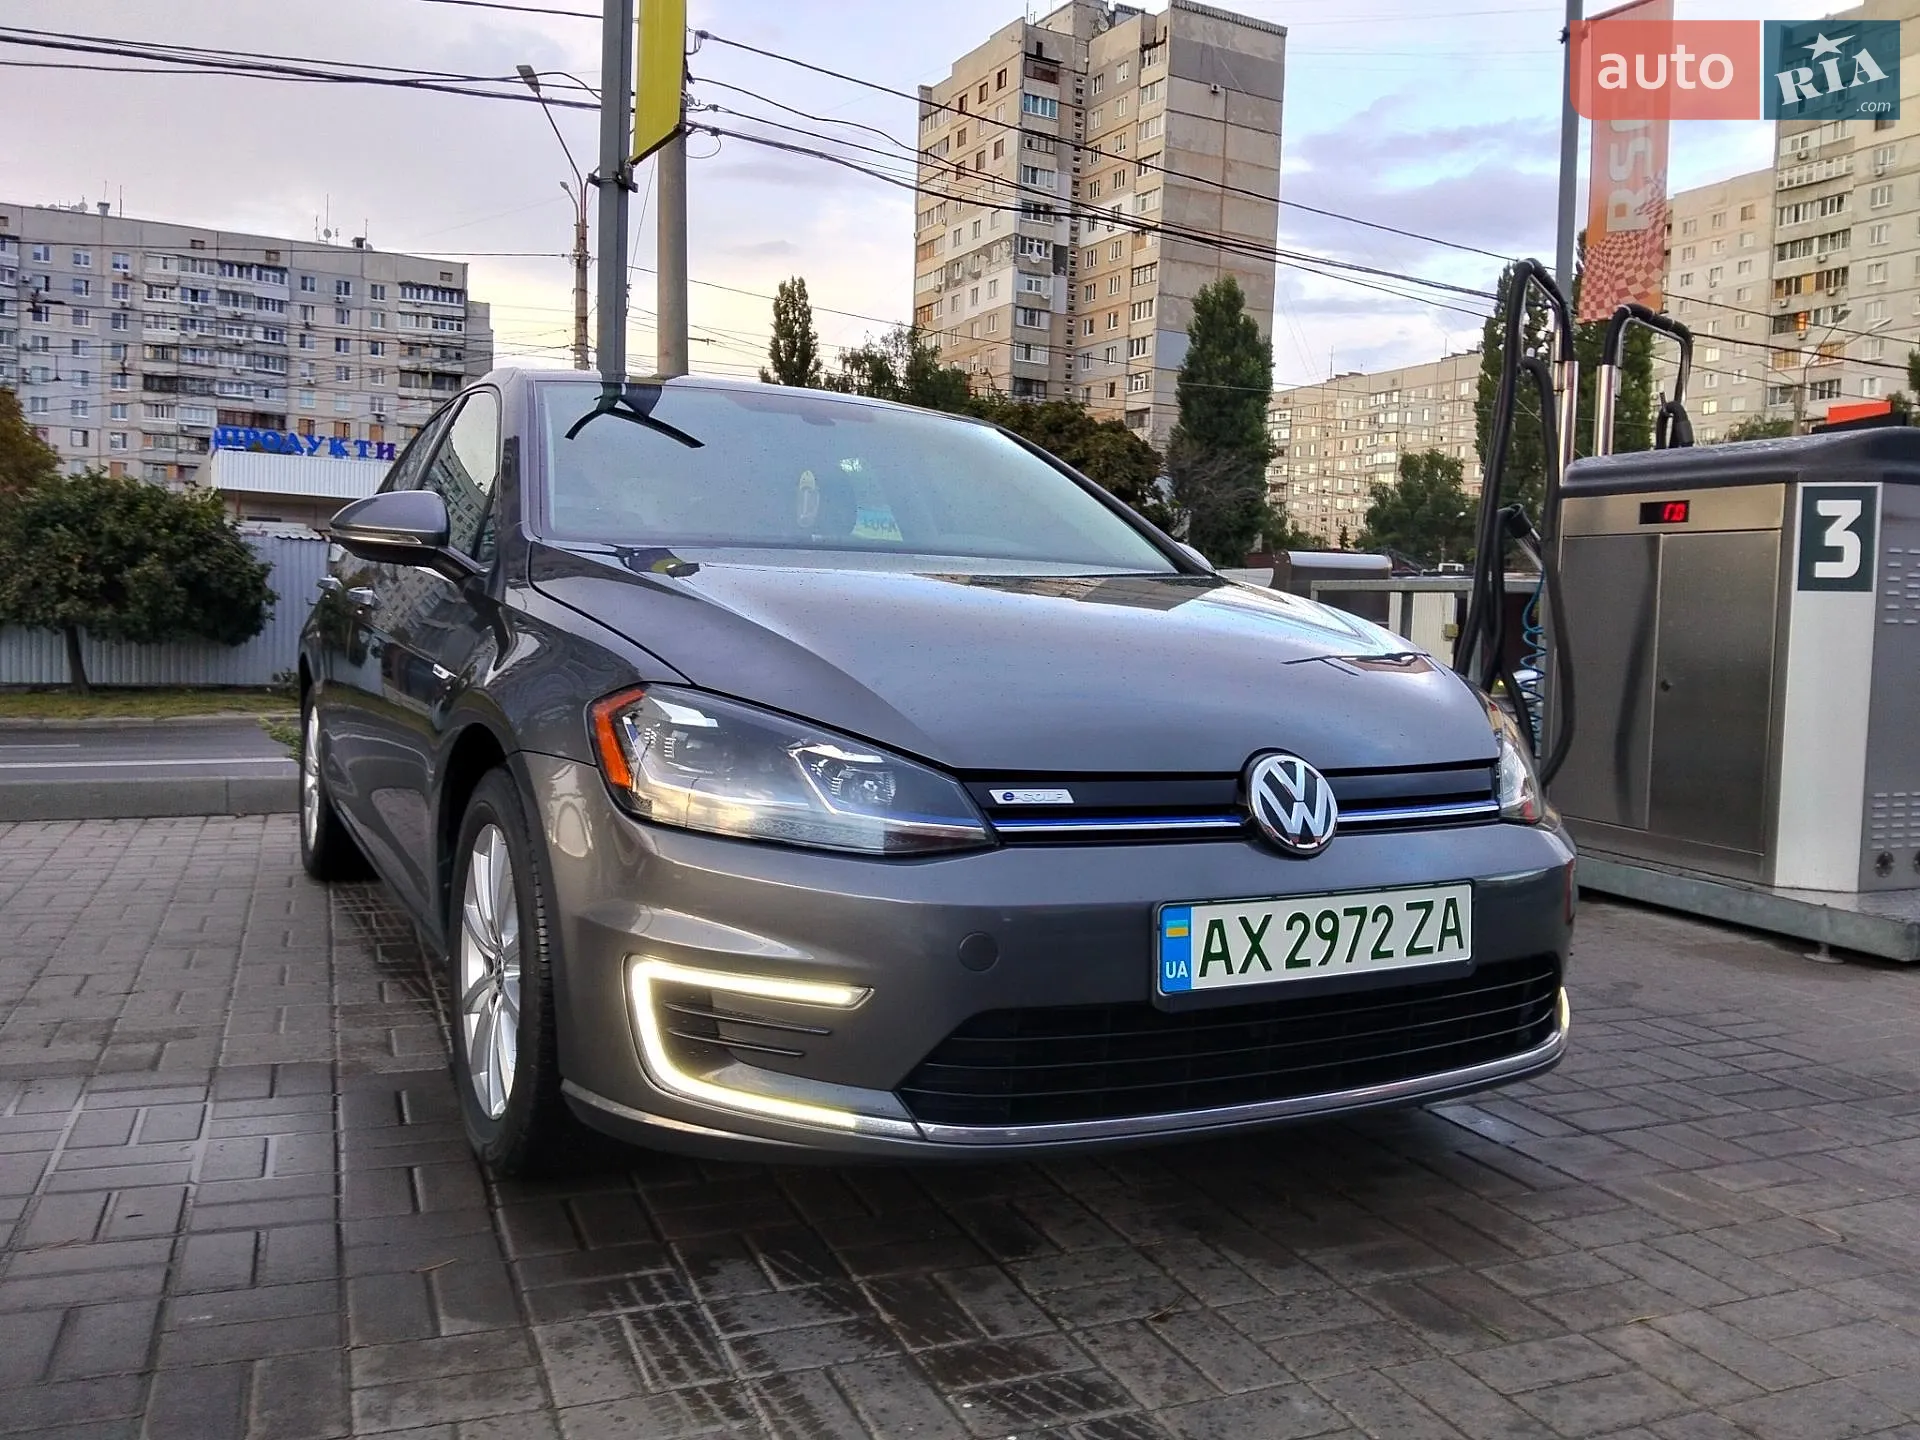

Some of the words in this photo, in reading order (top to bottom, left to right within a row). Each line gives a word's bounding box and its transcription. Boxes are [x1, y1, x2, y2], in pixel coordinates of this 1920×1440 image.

[215, 426, 397, 460] ПРОДУКТИ
[1815, 500, 1862, 578] 3
[1199, 914, 1273, 978] AX
[1285, 904, 1394, 970] 2972
[1405, 897, 1465, 958] ZA
[1165, 960, 1189, 979] UA
